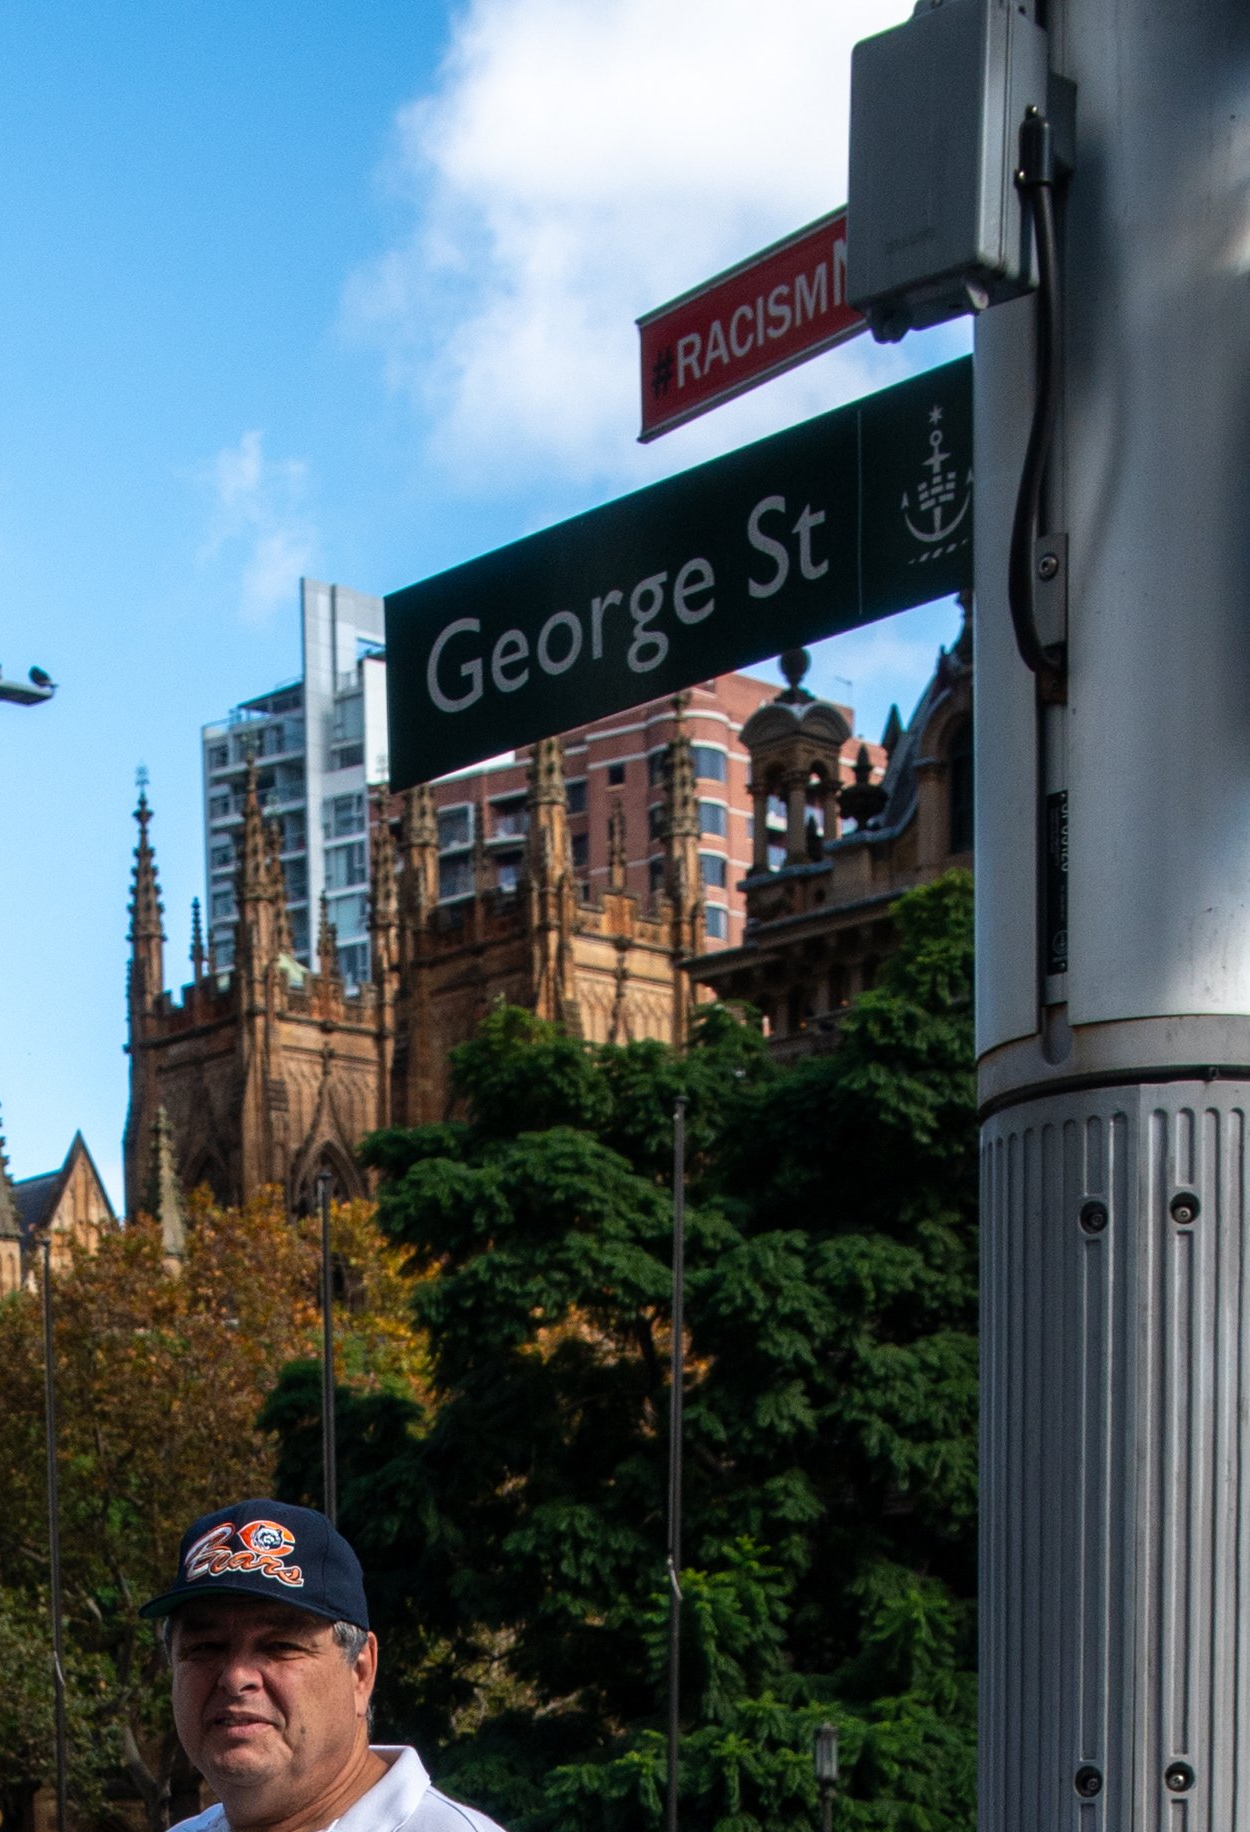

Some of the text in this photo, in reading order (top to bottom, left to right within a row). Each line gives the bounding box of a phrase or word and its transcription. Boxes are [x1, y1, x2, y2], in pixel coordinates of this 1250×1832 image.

[427, 495, 829, 713] George St
[184, 1522, 304, 1588] Bears
